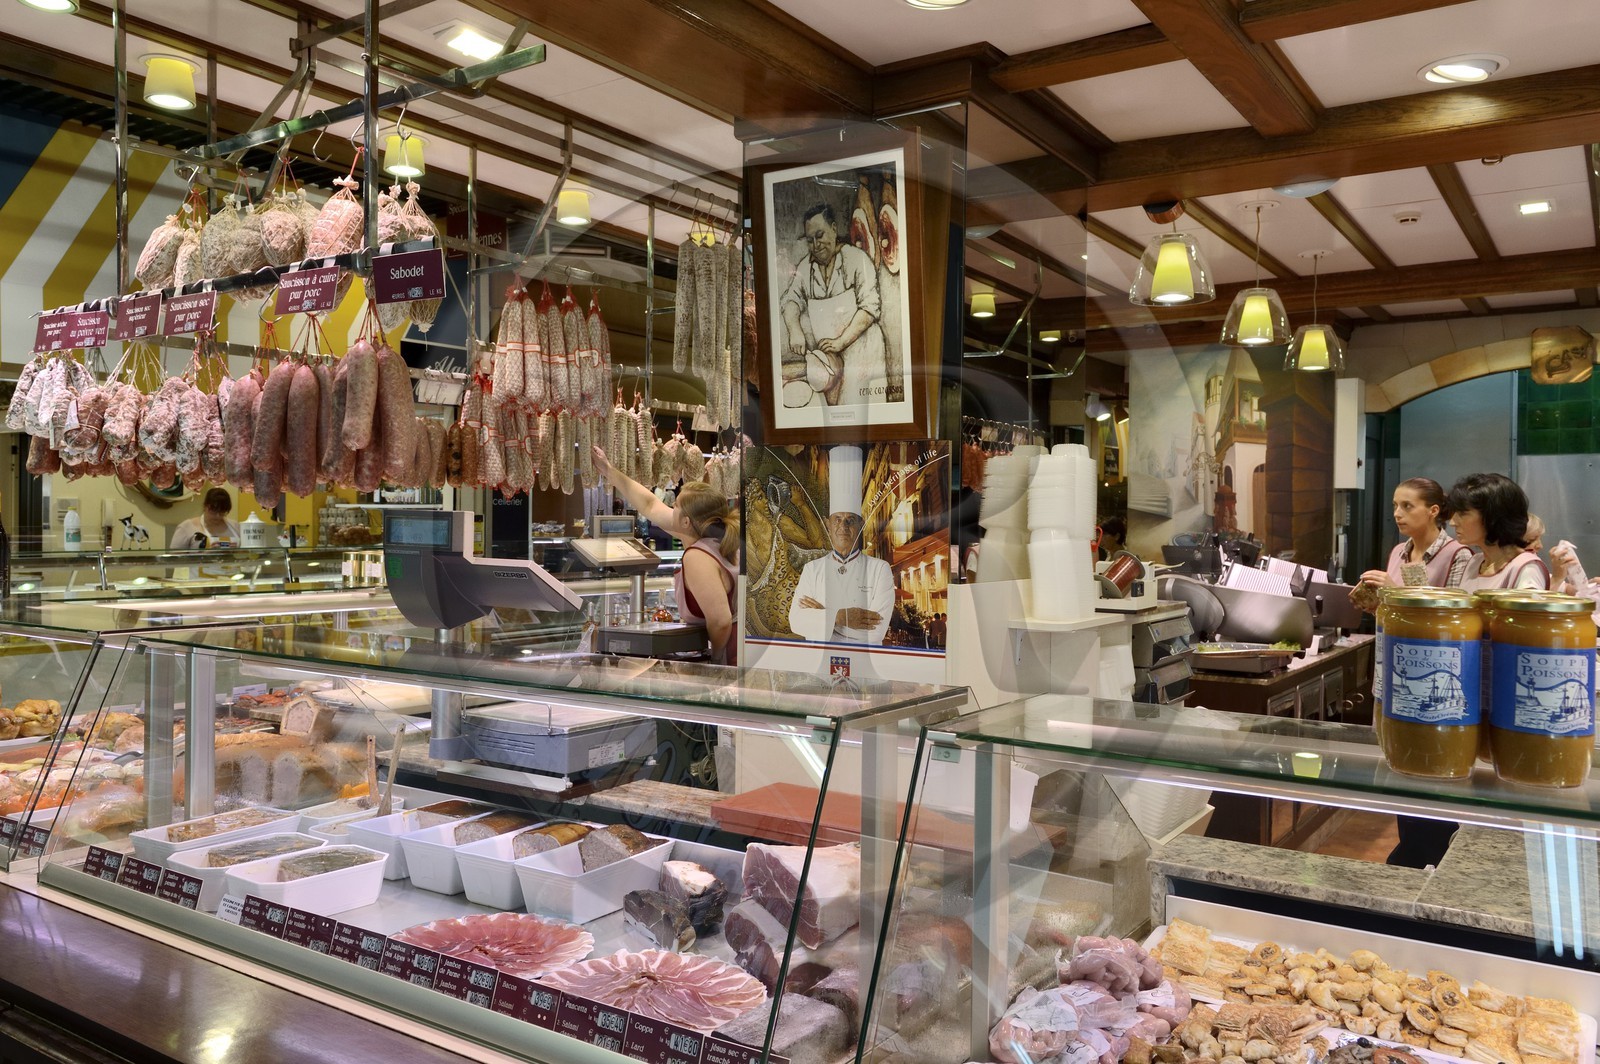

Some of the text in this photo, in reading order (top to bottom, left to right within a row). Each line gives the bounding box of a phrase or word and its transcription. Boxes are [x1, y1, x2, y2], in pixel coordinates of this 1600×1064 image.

[390, 265, 424, 280] Sabodet
[280, 276, 310, 289] Saucisson
[320, 273, 336, 284] cuire
[288, 288, 322, 302] pur porc
[170, 301, 197, 312] Saucisson
[174, 311, 201, 324] pur porc
[883, 463, 913, 489] heritage
[914, 455, 922, 466] of
[923, 449, 938, 460] life
[390, 943, 406, 953] Jambon
[393, 952, 406, 962] Alpes
[385, 963, 401, 973] Jambon
[444, 959, 462, 969] Jambon
[446, 969, 460, 978] Parme
[439, 980, 457, 990] Jambon
[502, 980, 517, 991] Bacon
[498, 999, 515, 1010] Salami
[565, 1002, 588, 1013] Pancetta
[561, 1020, 580, 1032] Salami
[634, 1022, 654, 1034] Coppa
[630, 1041, 644, 1052] Lard
[710, 1042, 726, 1054] Jésus
[728, 1049, 739, 1057] sec
[706, 1053, 731, 1064] tranché
